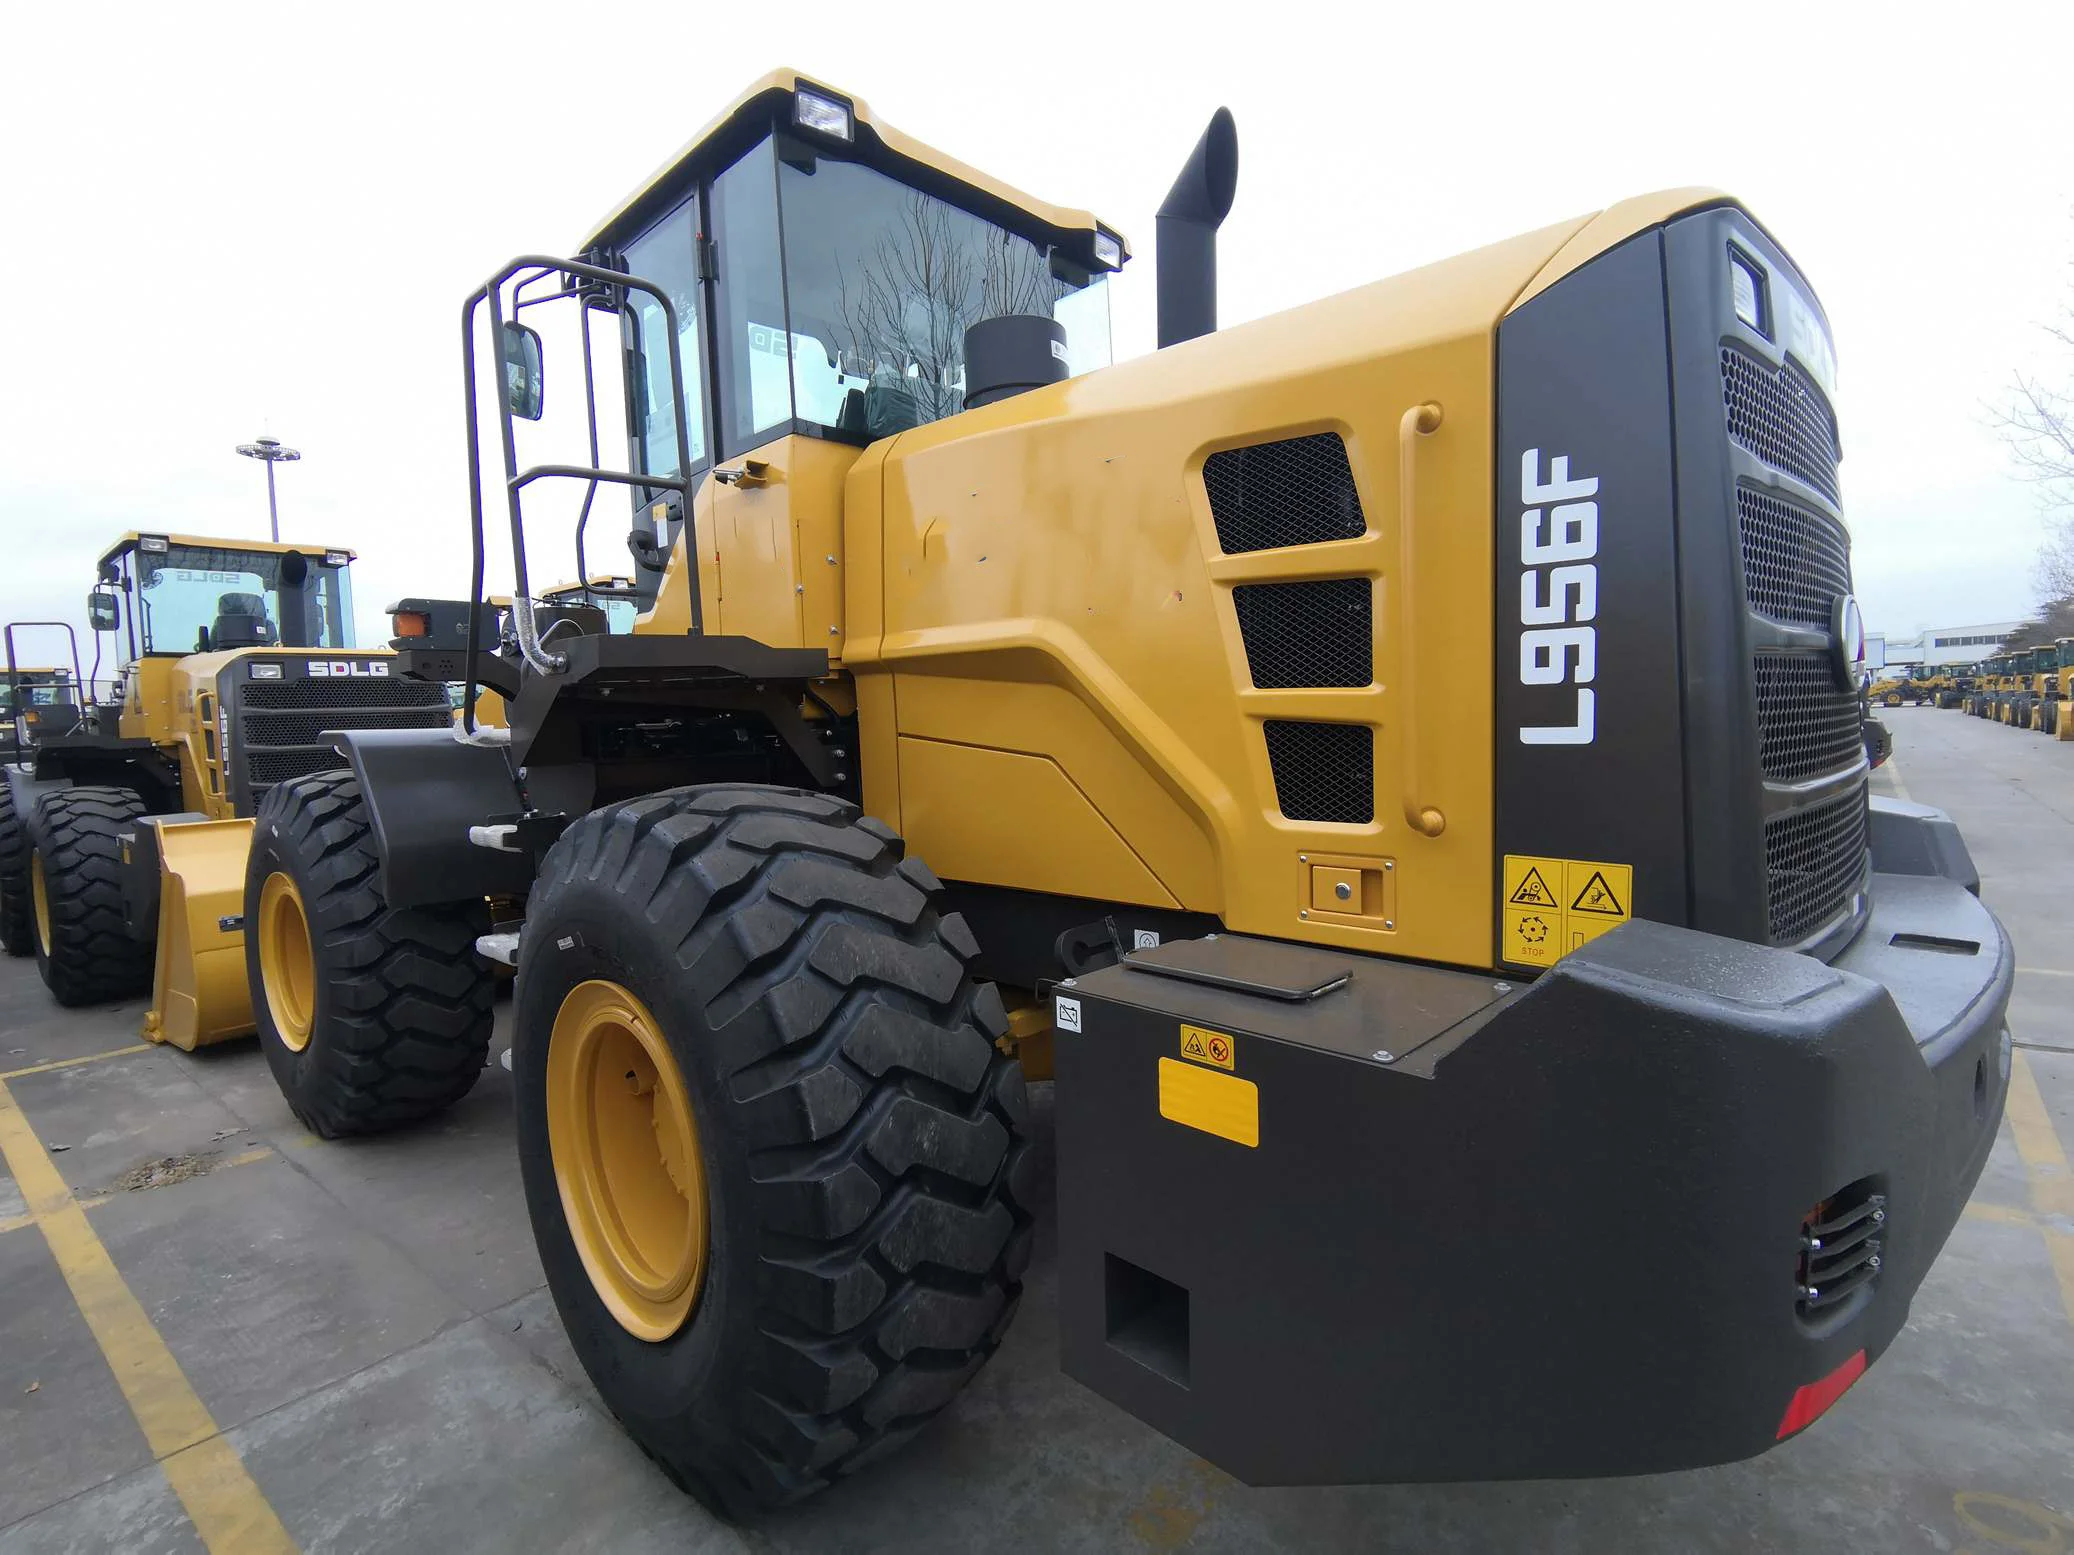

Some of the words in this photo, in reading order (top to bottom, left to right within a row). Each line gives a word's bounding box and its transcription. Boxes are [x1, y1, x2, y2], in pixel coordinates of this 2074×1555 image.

[1519, 447, 1599, 745] L956F
[308, 661, 389, 677] SDLG
[1520, 946, 1545, 957] STOP
